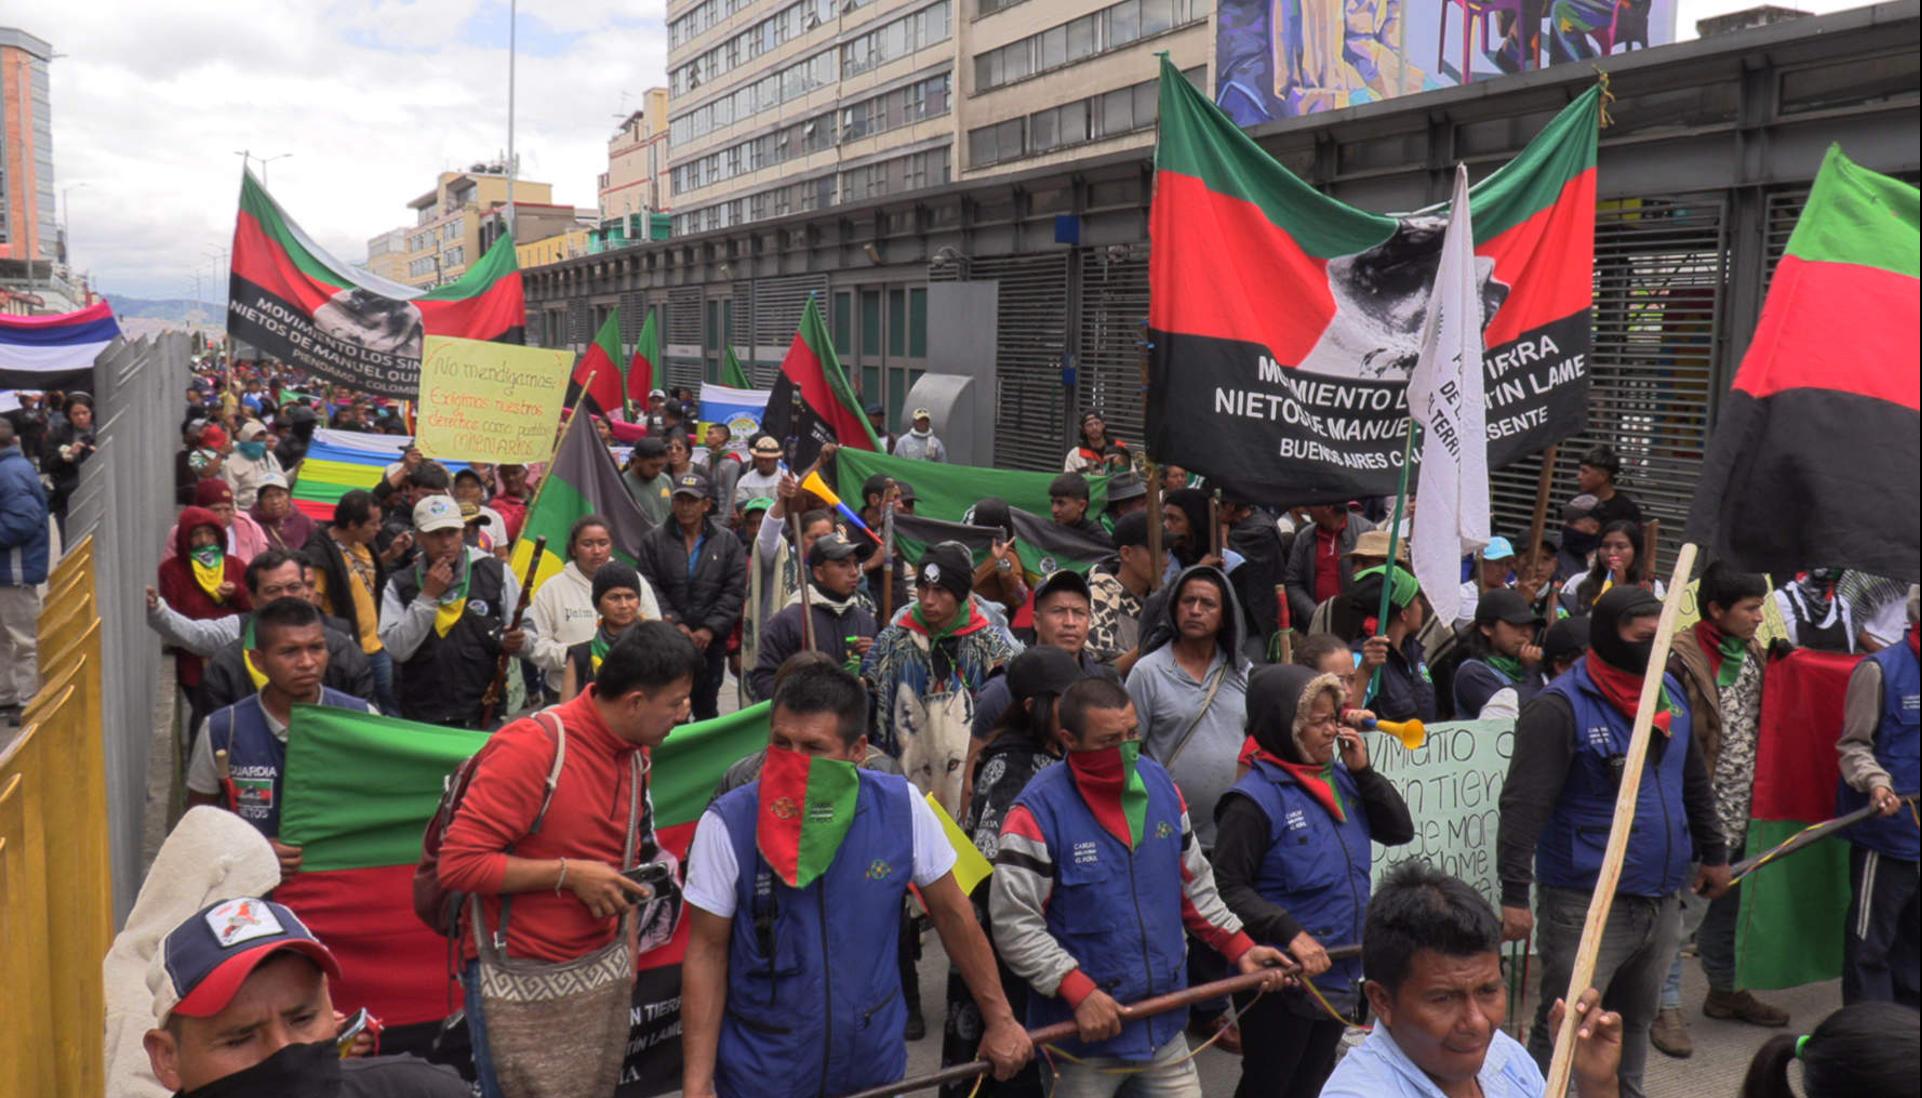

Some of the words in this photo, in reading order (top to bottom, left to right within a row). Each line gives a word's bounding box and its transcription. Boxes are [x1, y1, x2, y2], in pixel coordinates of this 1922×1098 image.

[228, 300, 288, 338] NIETOS
[289, 329, 312, 350] DE
[313, 345, 385, 380] MANUEL
[387, 368, 419, 383] QUI
[255, 297, 358, 357] MOVIMIENTO
[360, 349, 393, 367] LOS
[365, 380, 419, 395] COLOMB
[433, 356, 458, 377] No
[1327, 416, 1412, 442] MANUE
[1528, 354, 1586, 395] LAME
[1343, 452, 1390, 470] AIRES
[1486, 405, 1549, 442] SENTE
[1430, 409, 1462, 464] TERRI
